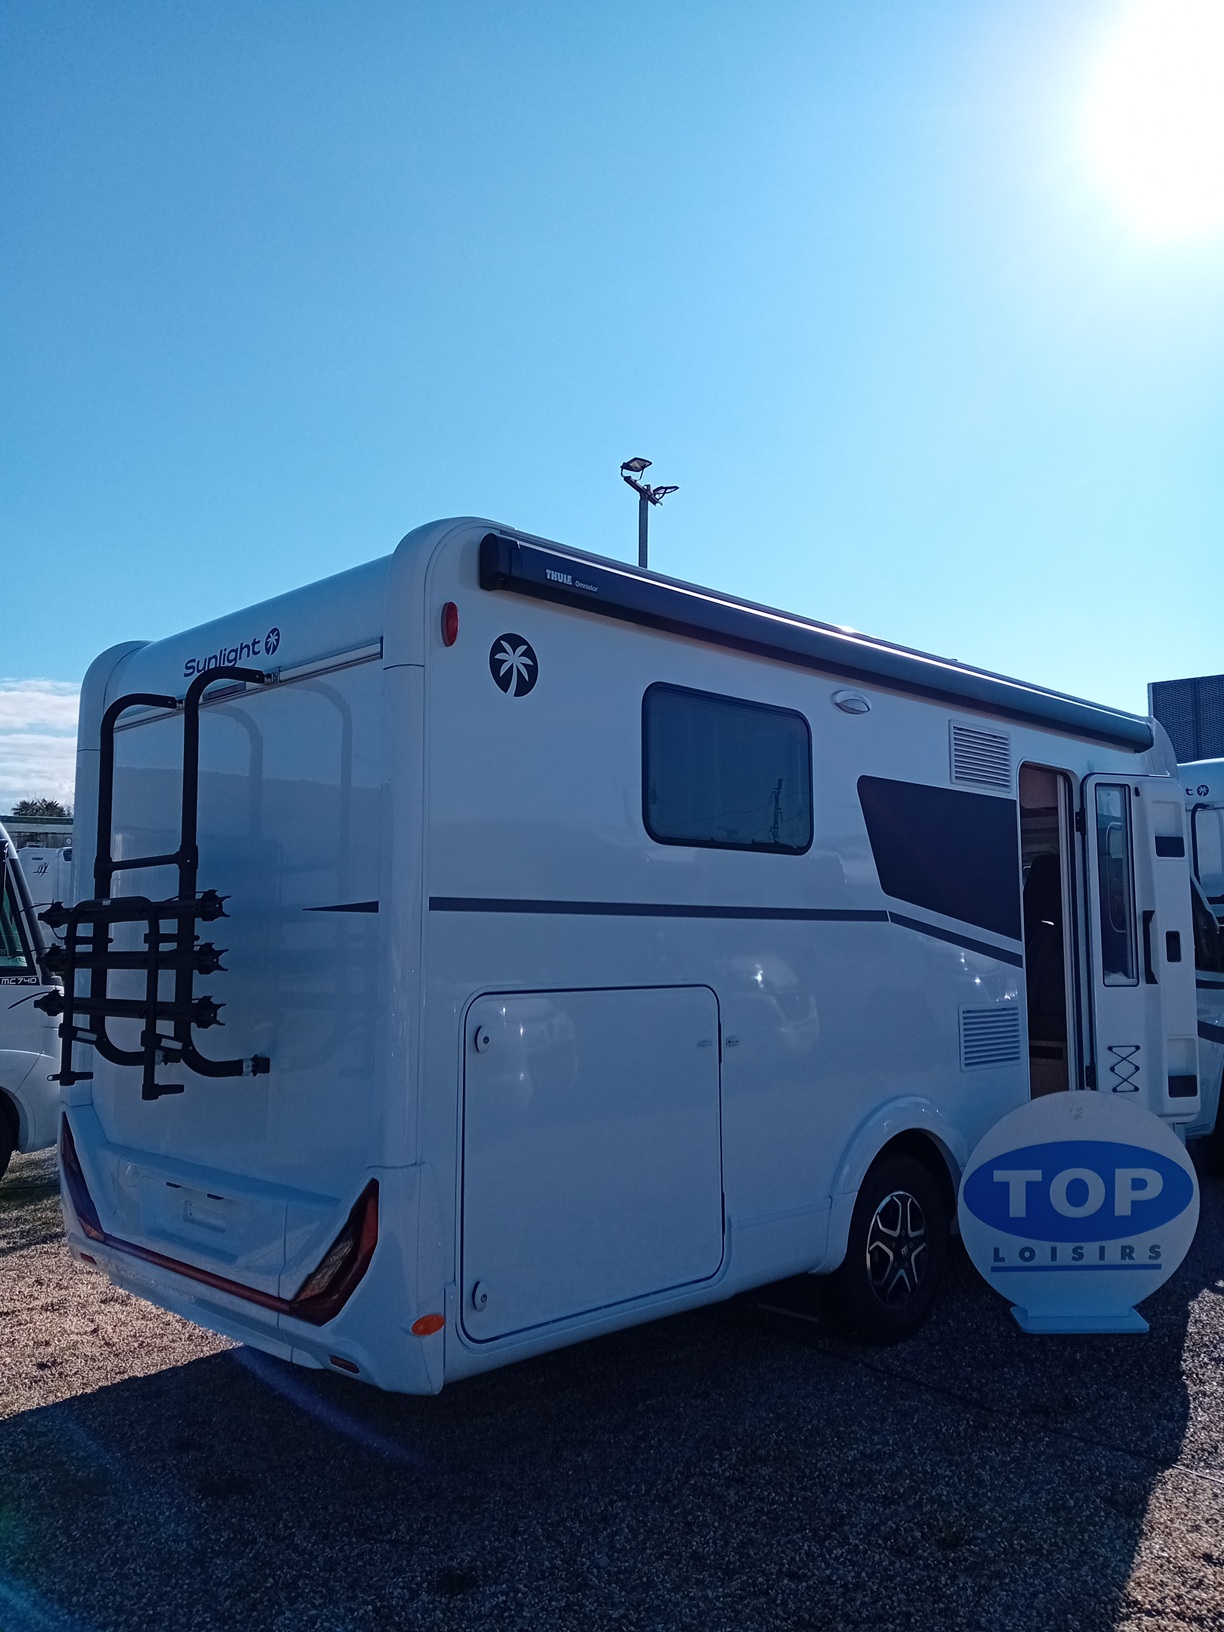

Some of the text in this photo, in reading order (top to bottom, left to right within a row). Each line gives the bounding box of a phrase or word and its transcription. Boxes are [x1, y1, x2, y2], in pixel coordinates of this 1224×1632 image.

[545, 569, 573, 586] THULE
[183, 637, 261, 678] Sunlight
[993, 1167, 1164, 1218] TOP
[993, 1244, 1163, 1263] LOISIRS
